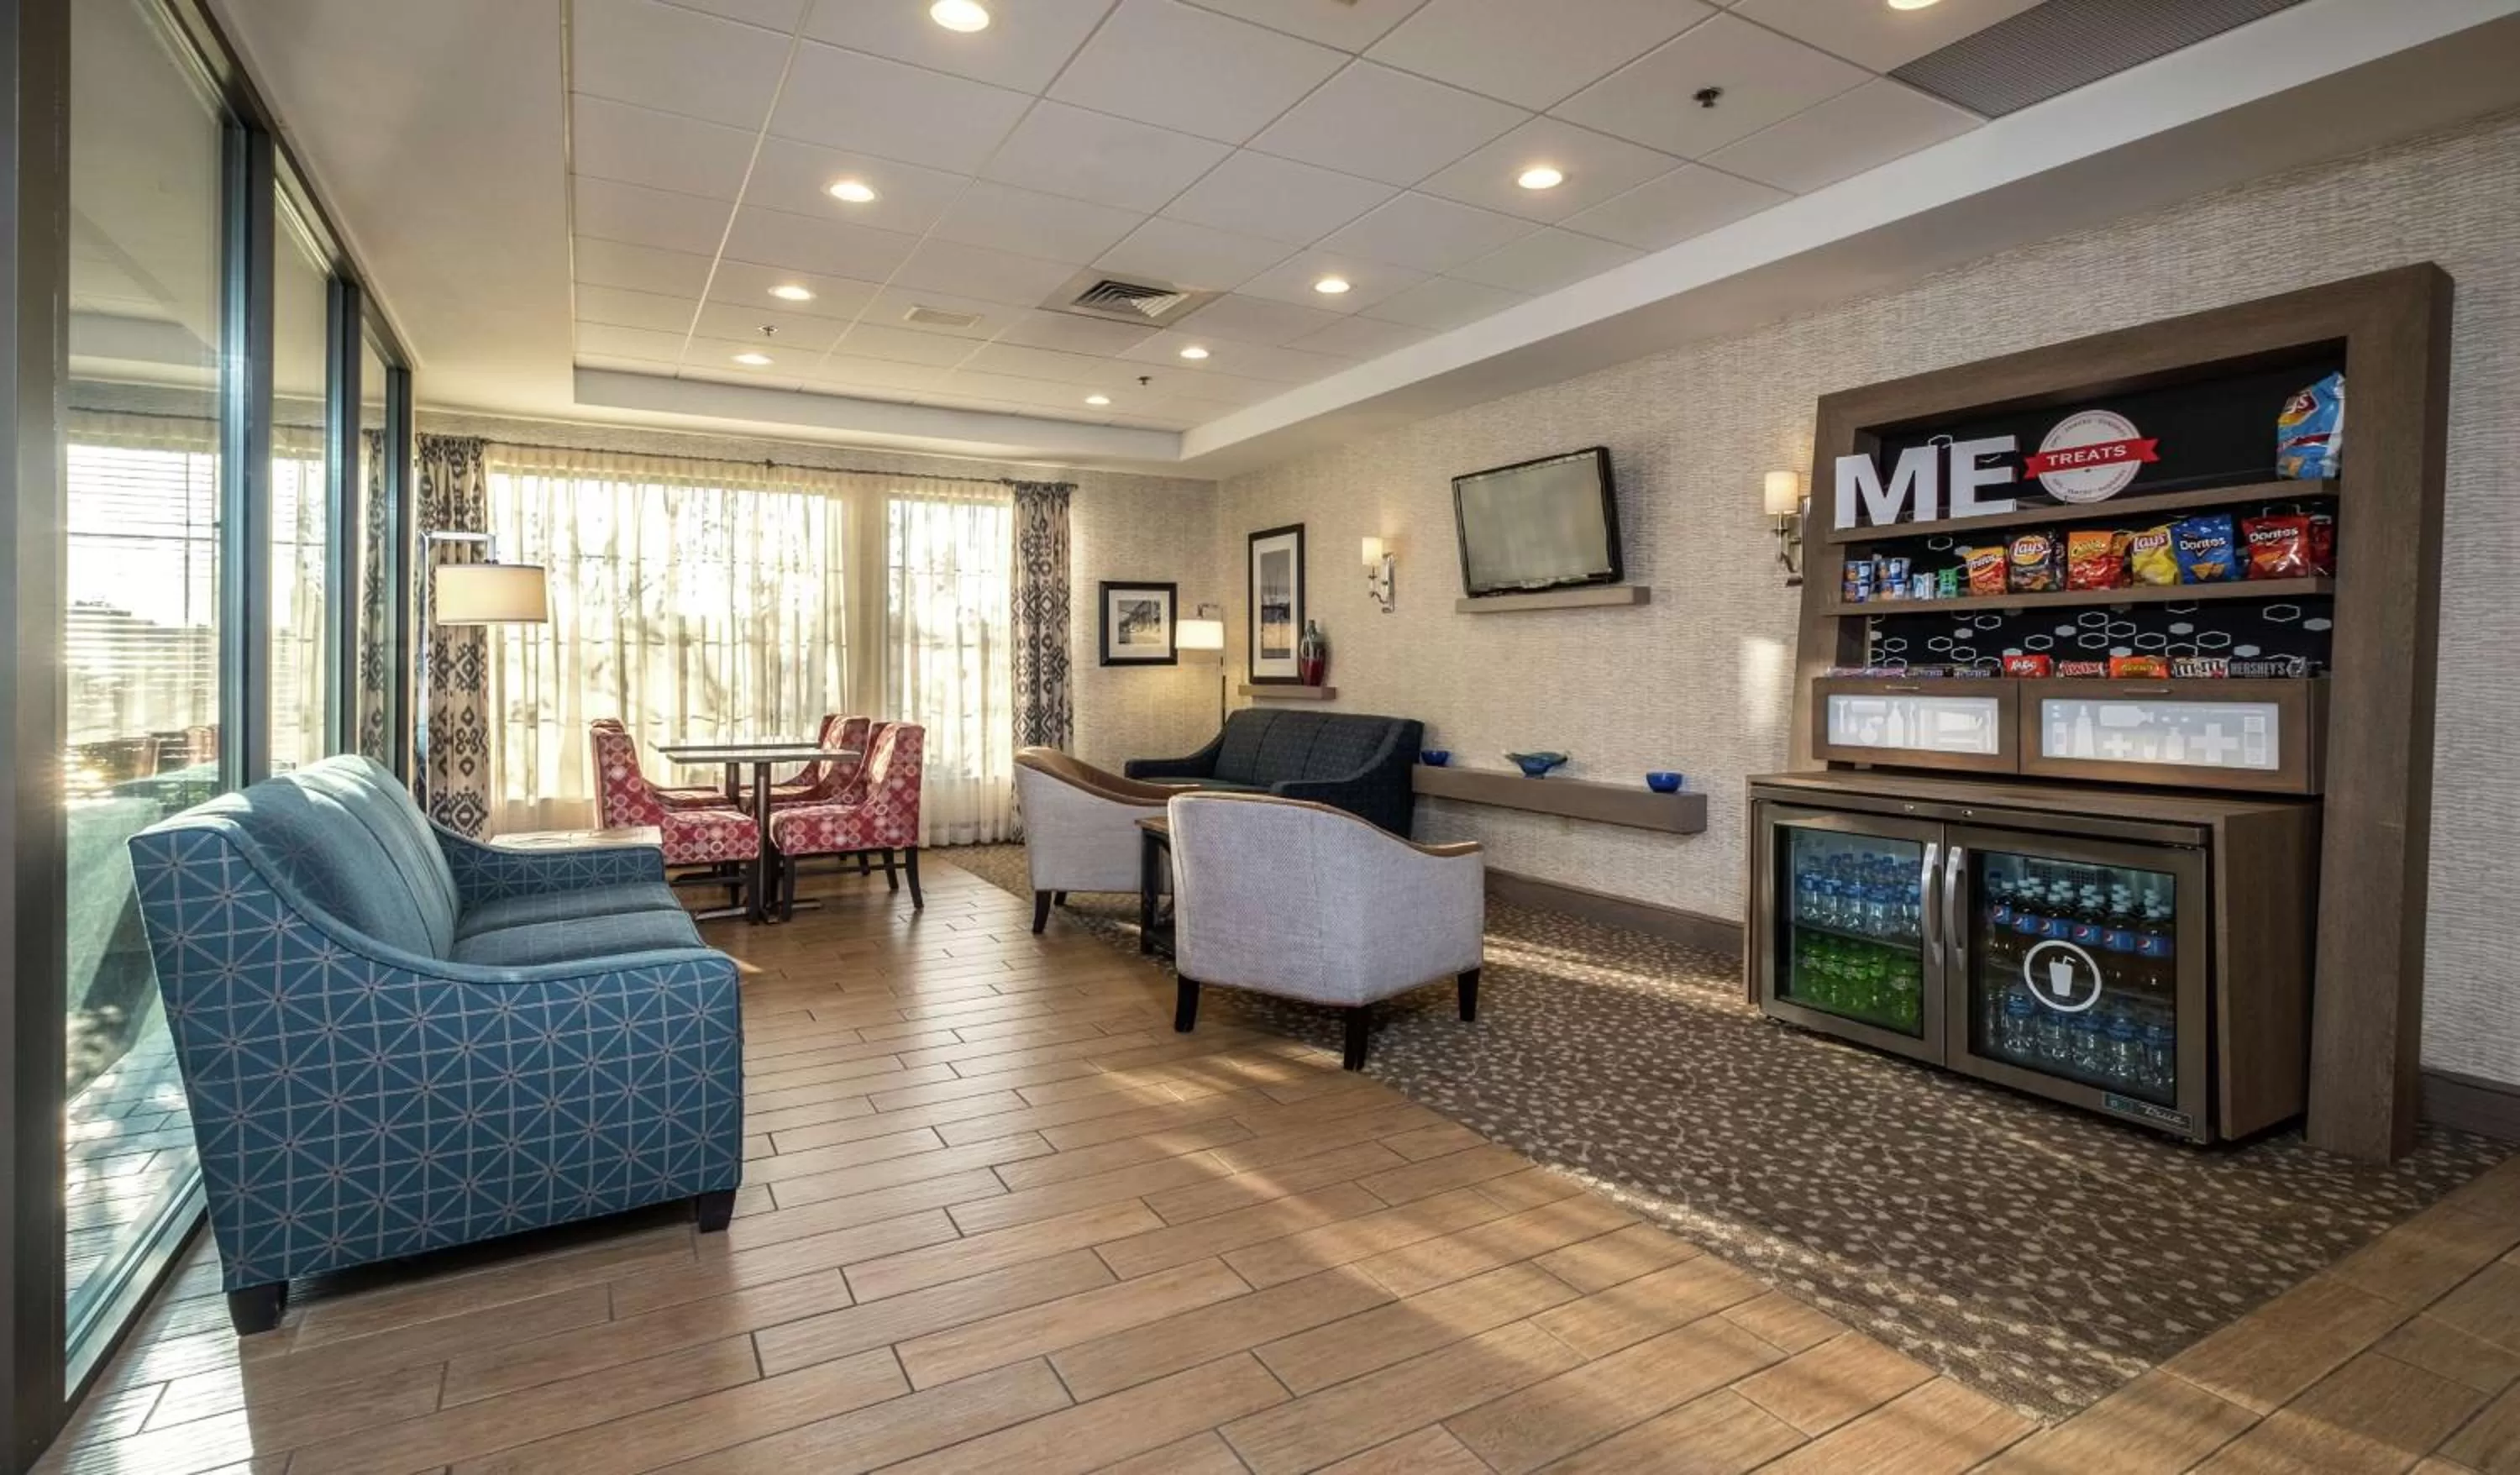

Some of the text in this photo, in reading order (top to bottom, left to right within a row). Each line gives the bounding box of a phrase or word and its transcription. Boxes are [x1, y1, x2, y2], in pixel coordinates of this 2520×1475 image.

[2046, 445, 2127, 466] TREATS
[1835, 435, 2016, 531] ME
[2180, 536, 2227, 551] Doritos
[2249, 527, 2299, 543] Doritos
